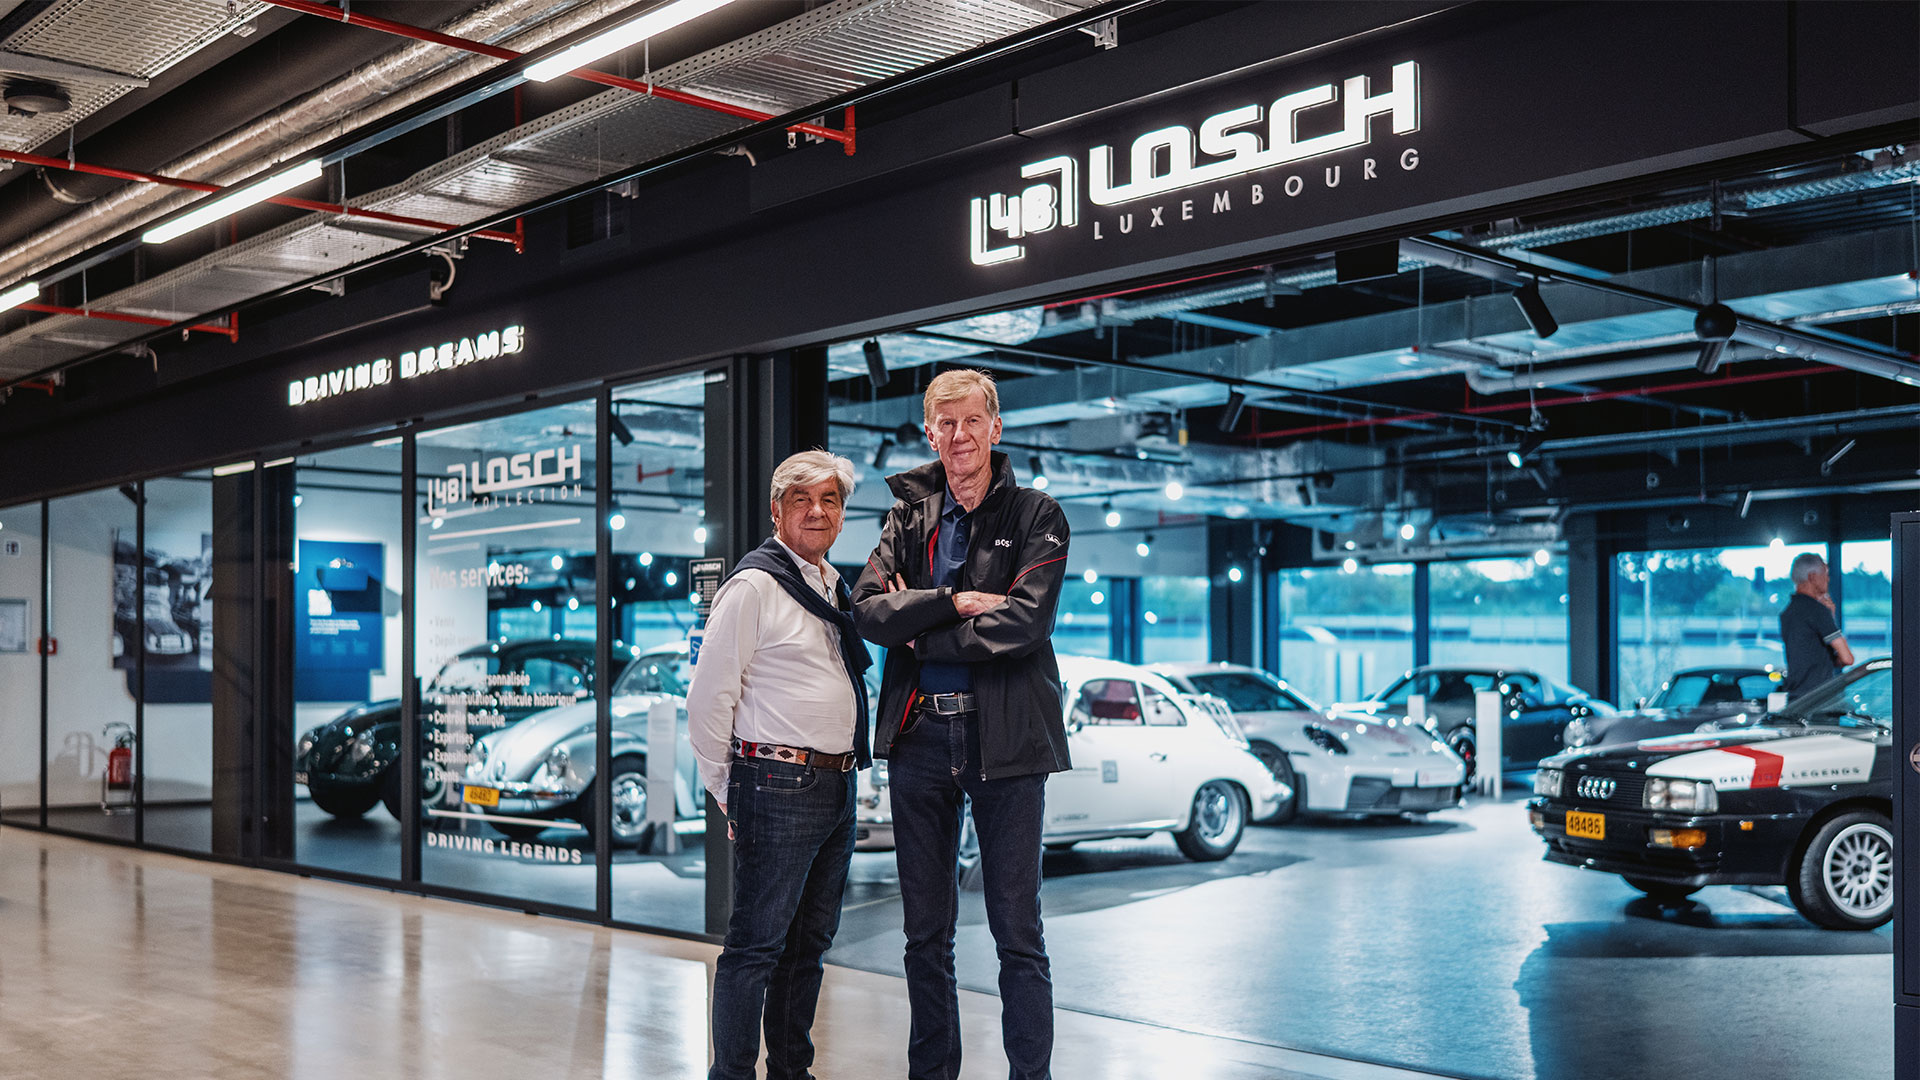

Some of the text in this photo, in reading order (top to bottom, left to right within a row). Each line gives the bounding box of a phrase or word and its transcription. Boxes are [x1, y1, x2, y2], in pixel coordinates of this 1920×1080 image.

[1089, 60, 1420, 206] LOSCH
[1094, 148, 1420, 240] LUXEMBOURG
[288, 325, 524, 406] DRIVING DREAMS
[471, 444, 581, 494] LOSCH
[471, 484, 582, 511] COLLECTION
[430, 563, 529, 589] Nos services:
[1791, 766, 1860, 778] LEGENDS
[1568, 815, 1601, 835] 48486
[427, 831, 582, 864] DRIVING LEGENDS
